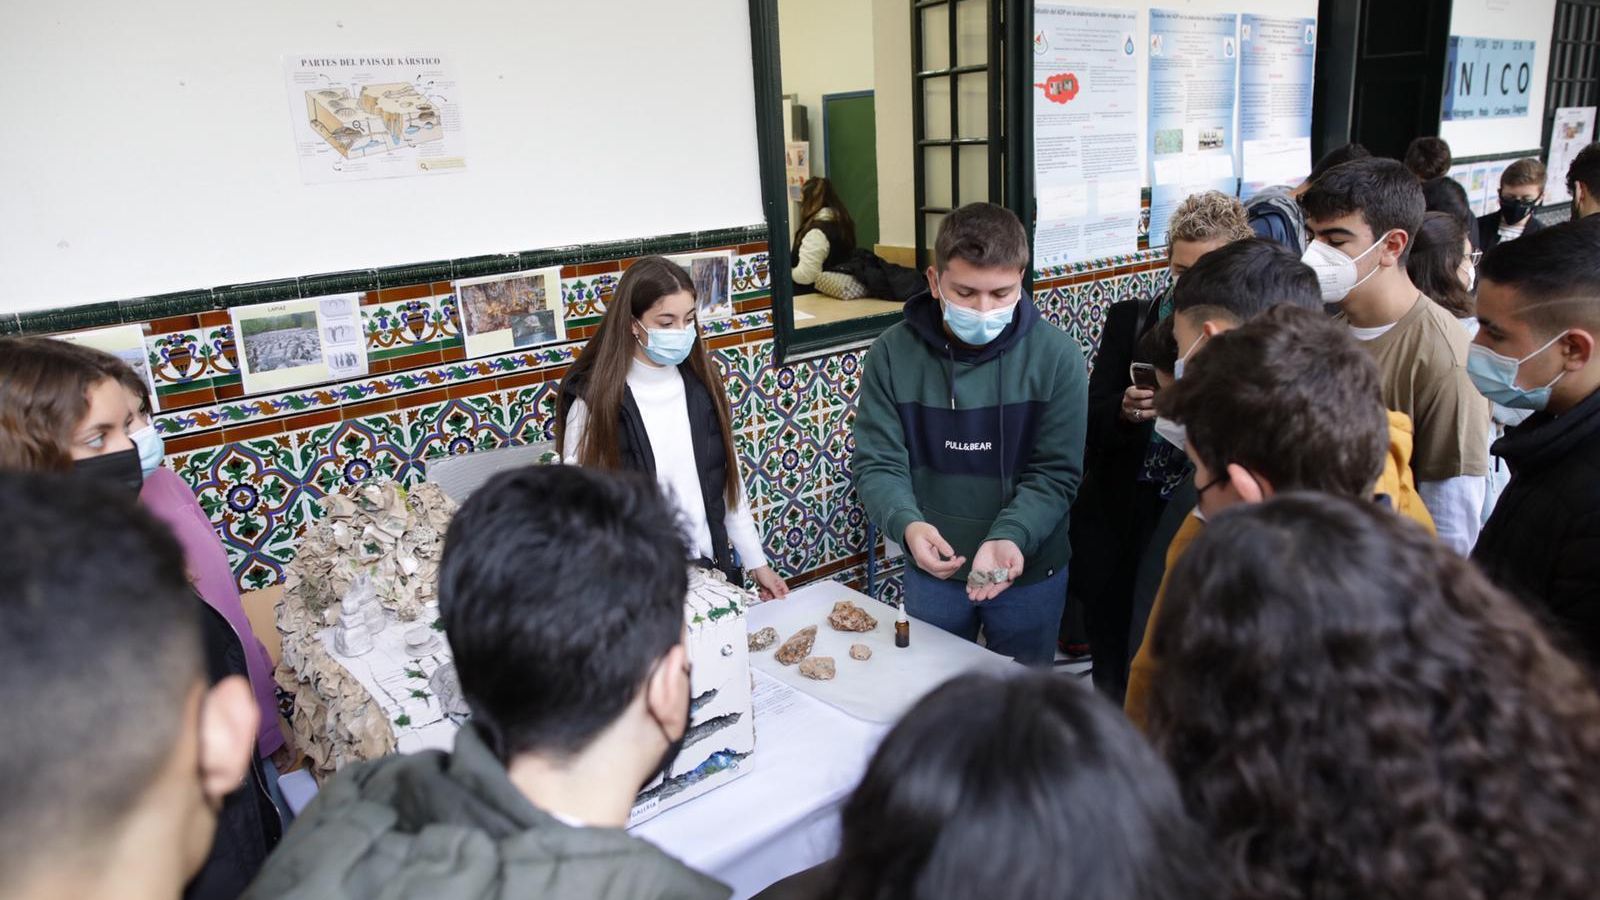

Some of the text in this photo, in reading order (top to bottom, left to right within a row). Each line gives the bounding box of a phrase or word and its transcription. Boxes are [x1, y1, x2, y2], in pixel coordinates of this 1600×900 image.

[301, 56, 440, 67] PARTES DEL PAISAJE KÁRSTICO
[945, 440, 992, 451] PULL&BEAR
